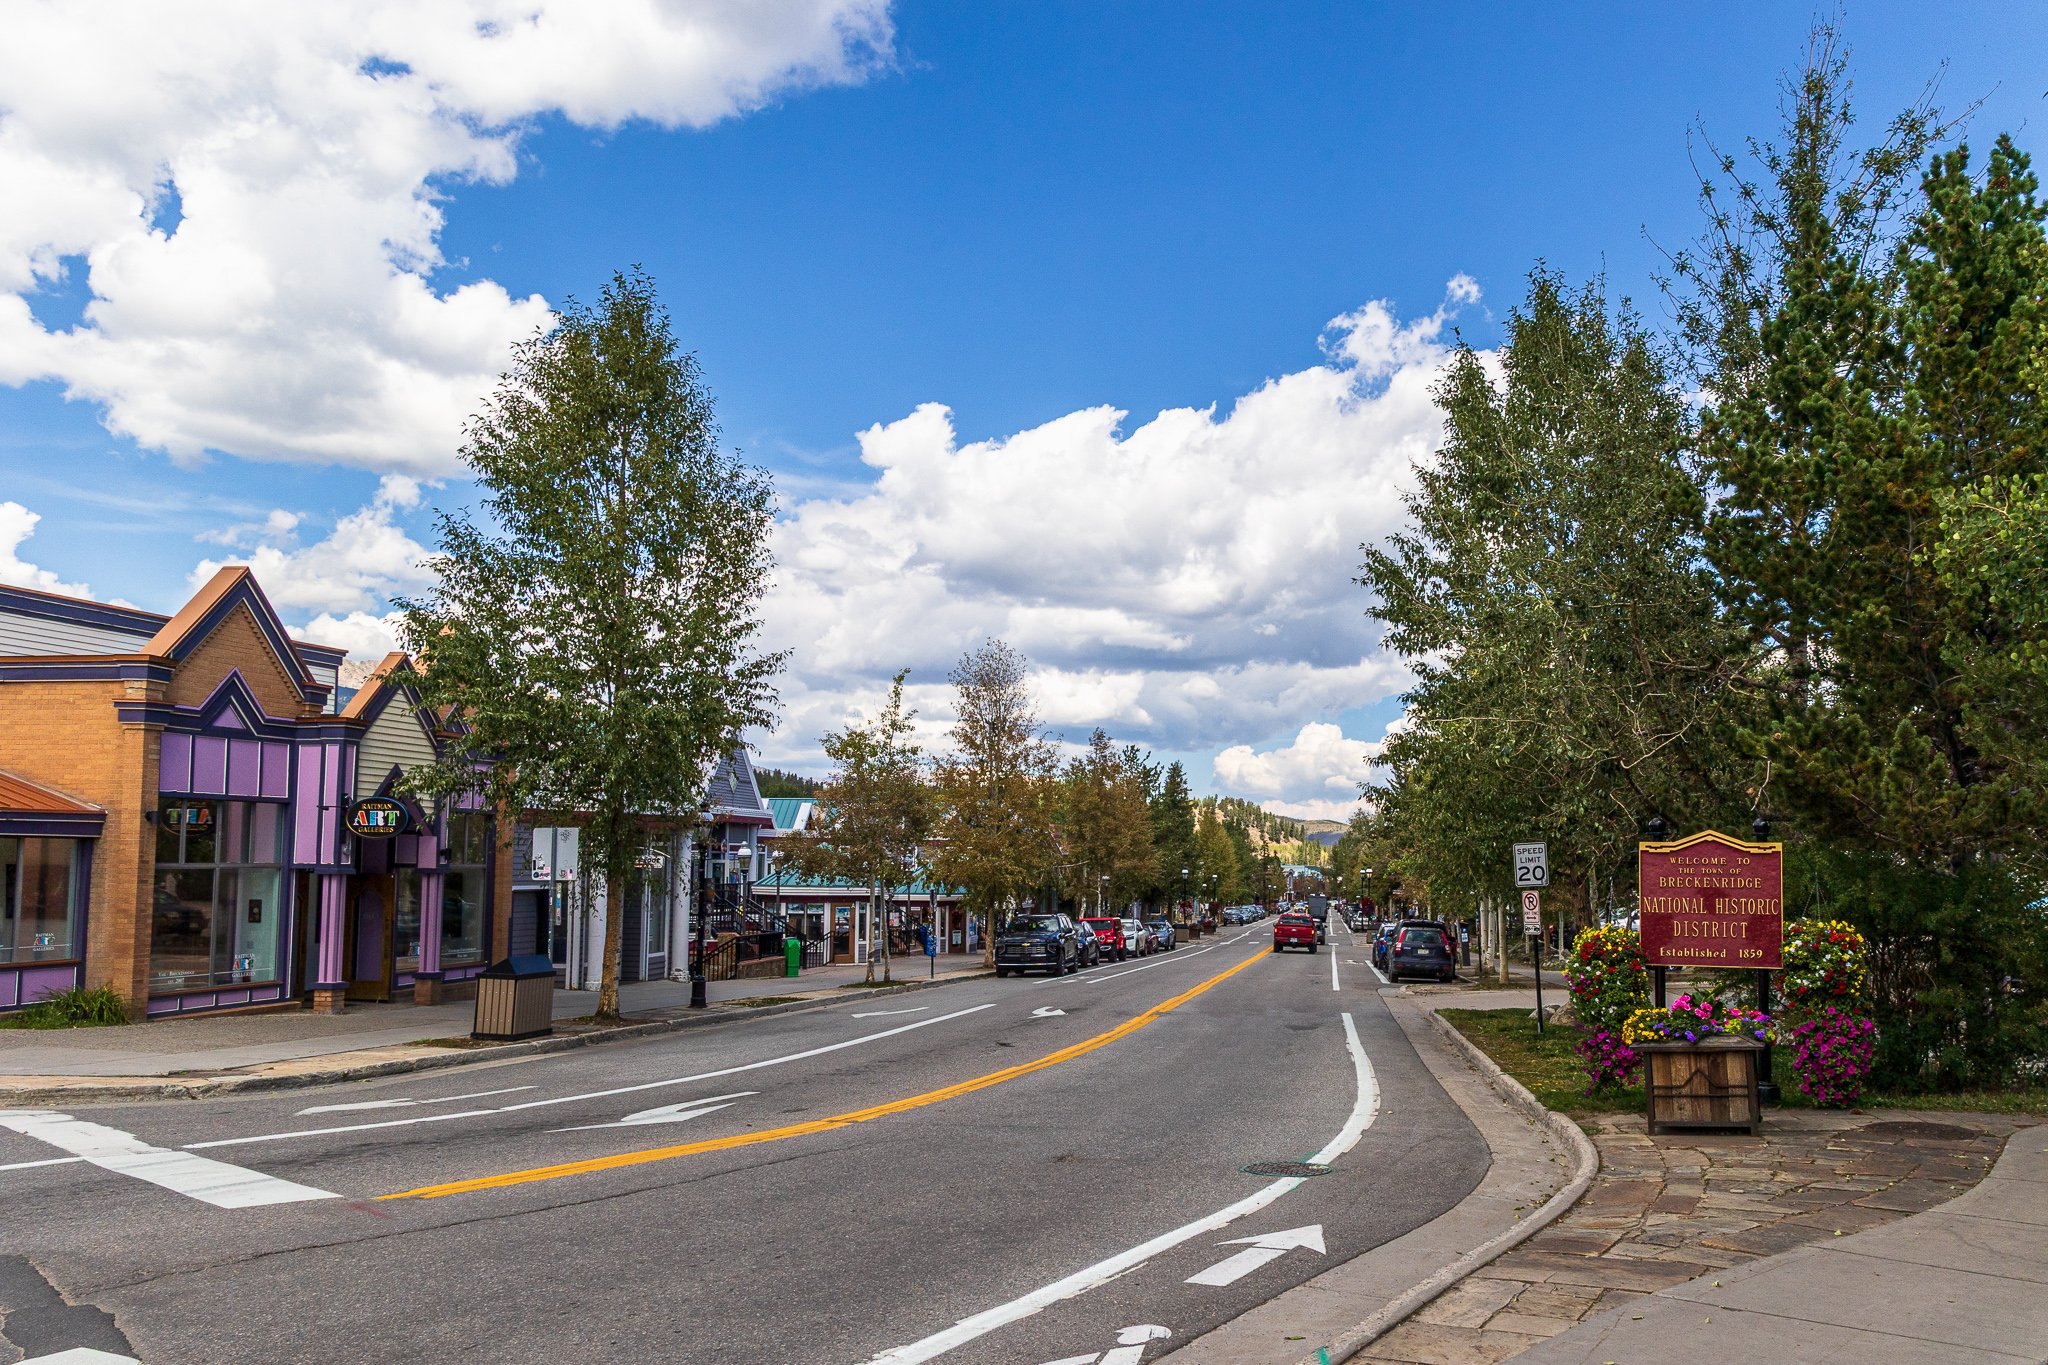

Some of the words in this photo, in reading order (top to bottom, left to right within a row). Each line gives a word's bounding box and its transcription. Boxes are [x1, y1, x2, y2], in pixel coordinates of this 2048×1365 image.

[353, 810, 400, 826] ART
[1516, 847, 1544, 855] SPEED
[1520, 856, 1541, 864] LIMIT
[1669, 857, 1727, 865] WELCOME
[1737, 857, 1750, 865] TO
[1517, 865, 1545, 882] 20
[1659, 876, 1762, 889] BRECKENRIDGE
[1643, 896, 1707, 914] NATIONAL
[1715, 898, 1779, 915] HISTORIC
[1673, 920, 1748, 938] DISTRICT
[1660, 947, 1727, 958] Established
[1739, 948, 1763, 959] 1859
